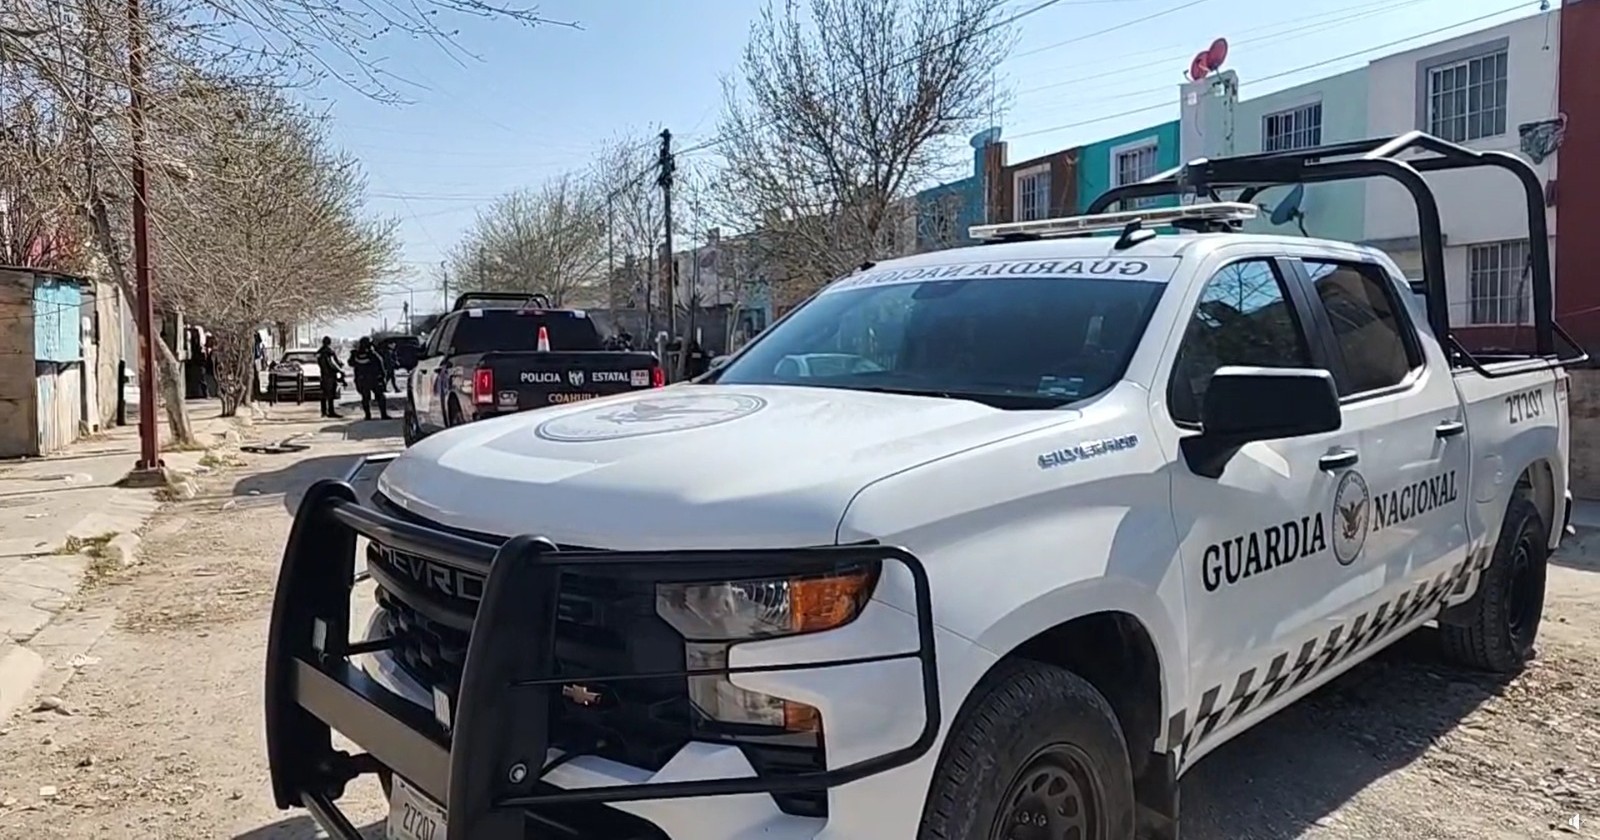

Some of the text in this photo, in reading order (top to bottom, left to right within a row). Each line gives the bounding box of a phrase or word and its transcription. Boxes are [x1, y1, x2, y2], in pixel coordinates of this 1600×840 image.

[520, 372, 561, 383] POLICIA
[592, 372, 629, 382] ESTATAL
[1505, 388, 1545, 424] 27207
[1202, 511, 1326, 592] GUARDIA
[1372, 470, 1458, 532] NACIONAL
[403, 802, 436, 840] 27207
